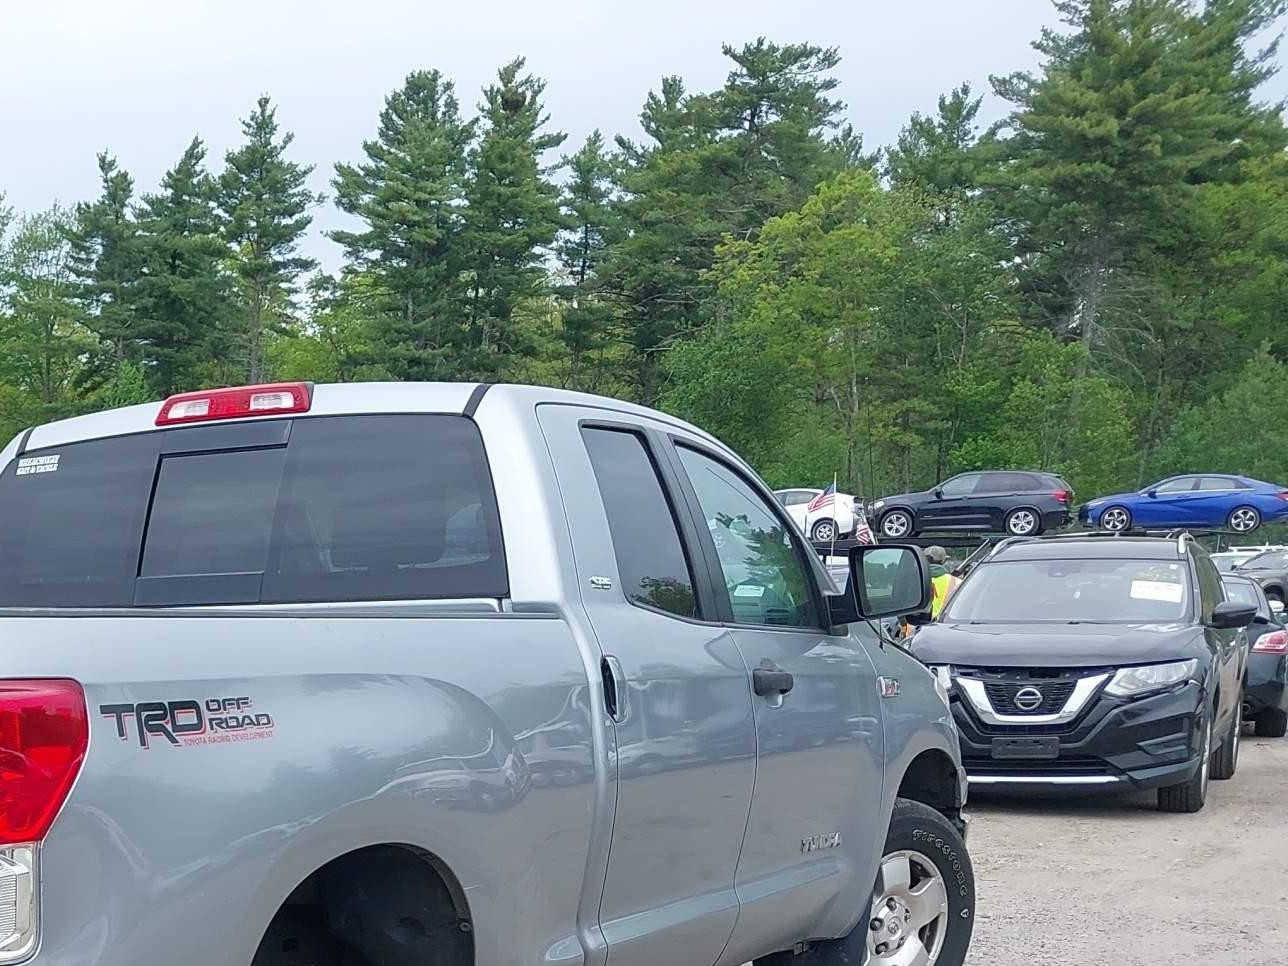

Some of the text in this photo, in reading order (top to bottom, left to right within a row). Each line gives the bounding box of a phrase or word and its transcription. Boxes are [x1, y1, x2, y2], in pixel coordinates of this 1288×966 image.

[205, 697, 251, 714] OFF
[99, 700, 206, 749] TRD
[208, 714, 274, 732] ROAD
